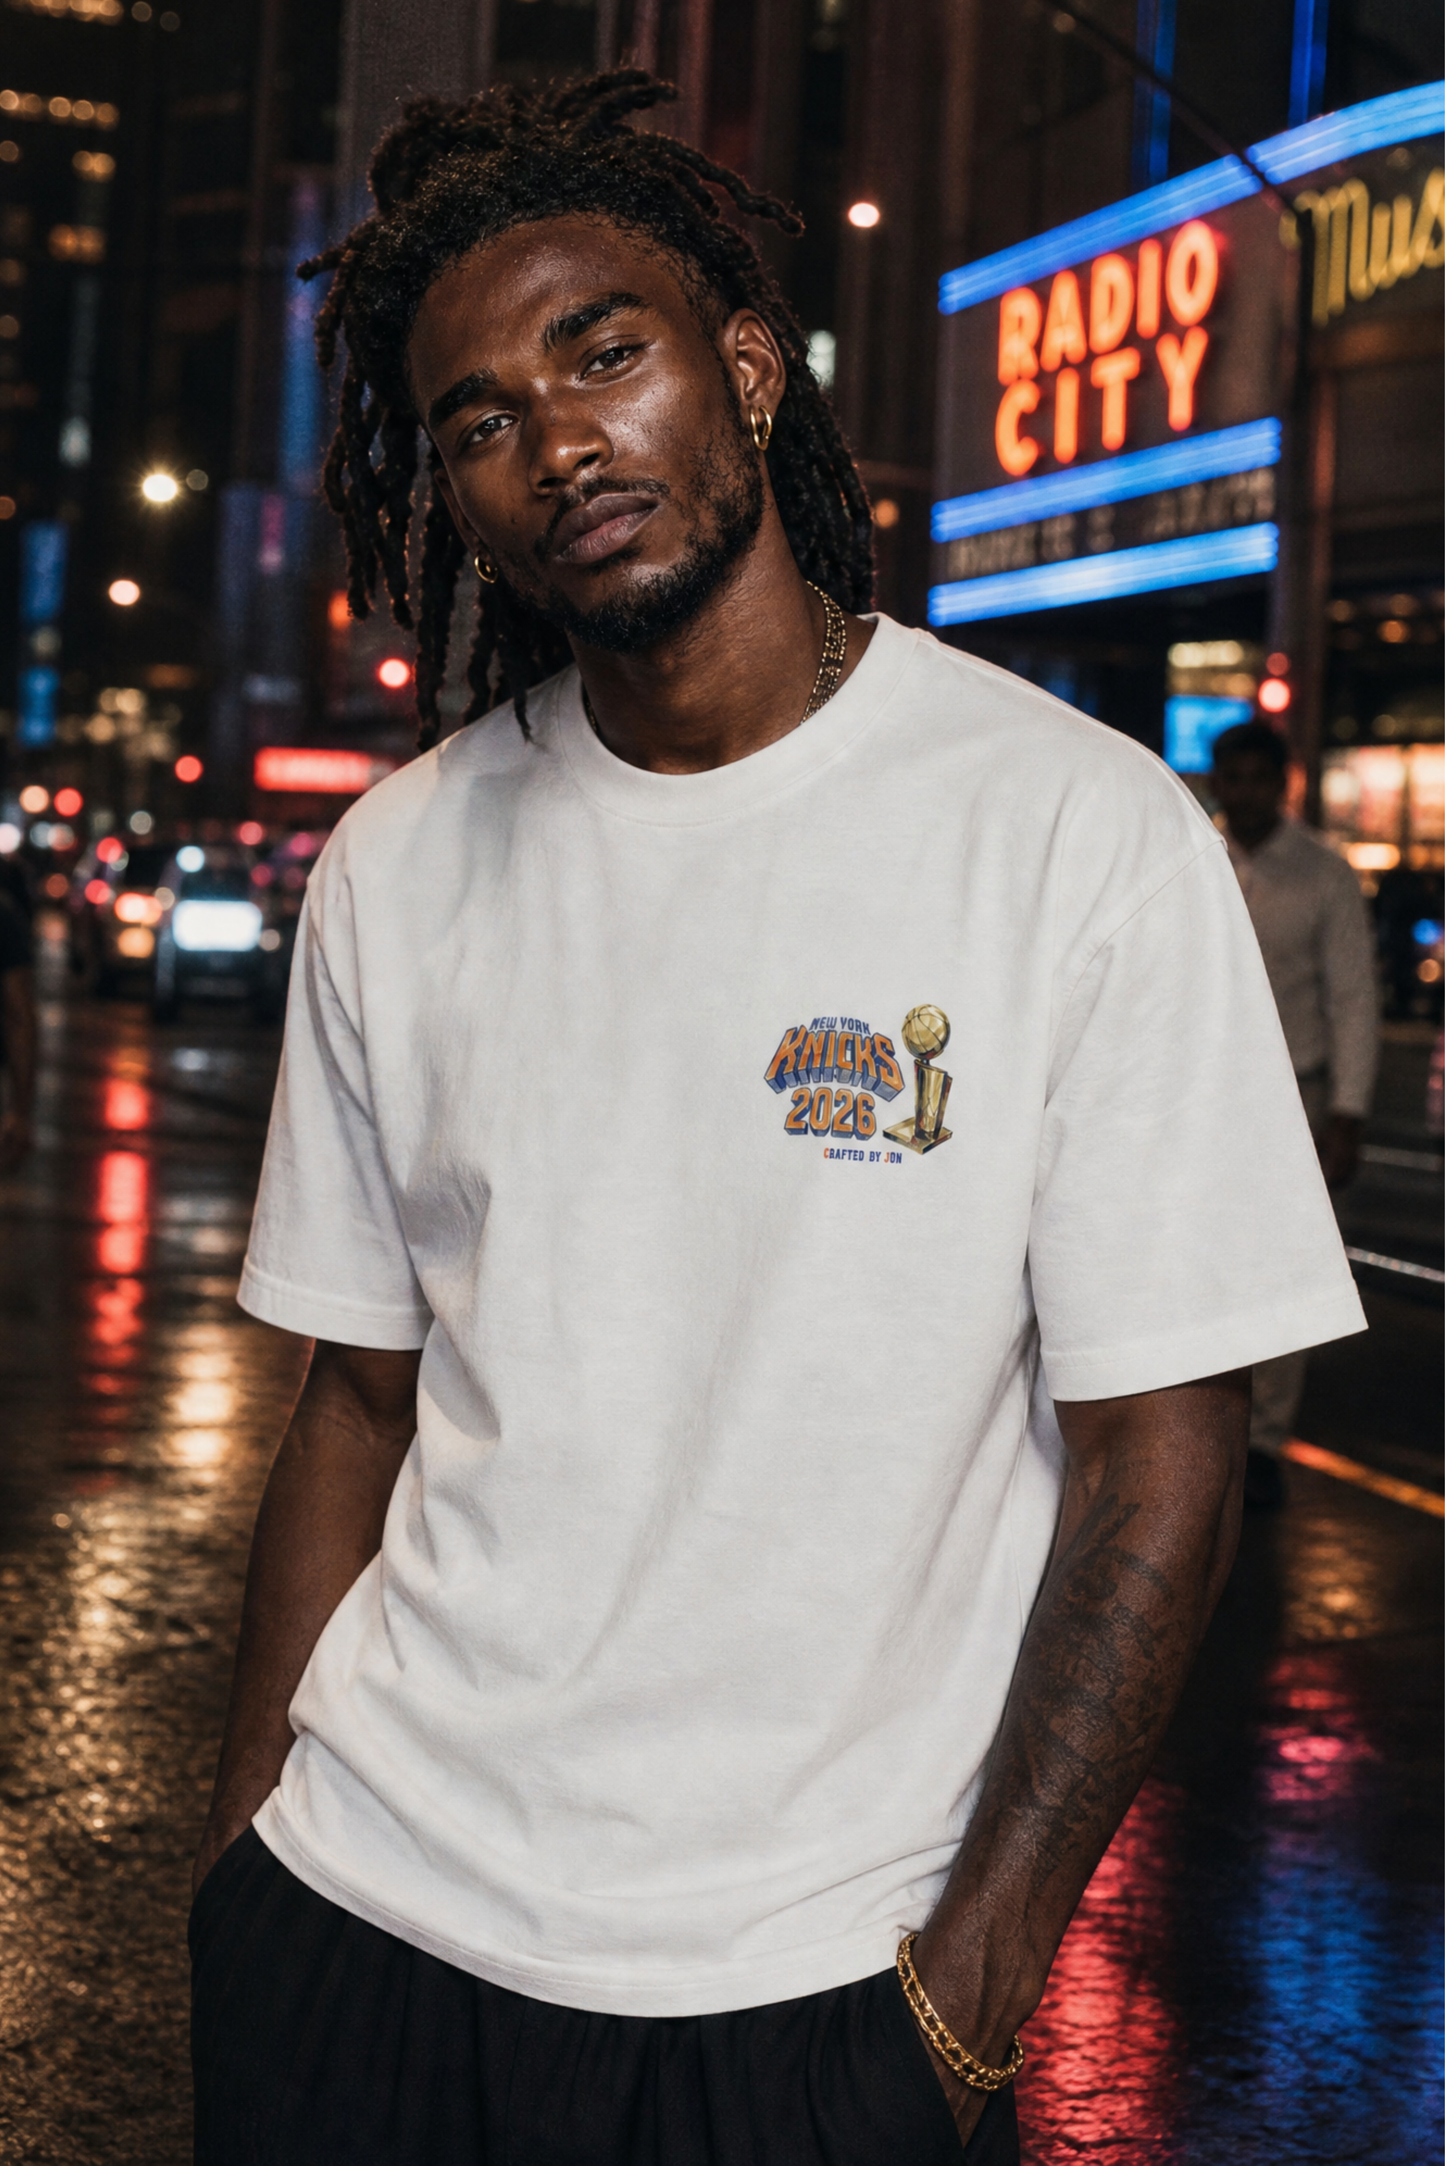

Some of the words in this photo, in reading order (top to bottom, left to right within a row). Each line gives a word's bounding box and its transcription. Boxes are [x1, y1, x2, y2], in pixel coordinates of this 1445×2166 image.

[998, 220, 1219, 386] RADIO
[995, 327, 1209, 477] CITY
[809, 1017, 837, 1031] NEW
[840, 1017, 871, 1035] YORK
[763, 1024, 906, 1103] KNICKS
[784, 1087, 877, 1141] 2026
[823, 1147, 865, 1162] CRAFTED
[869, 1151, 882, 1162] BY
[884, 1152, 903, 1164] JON
